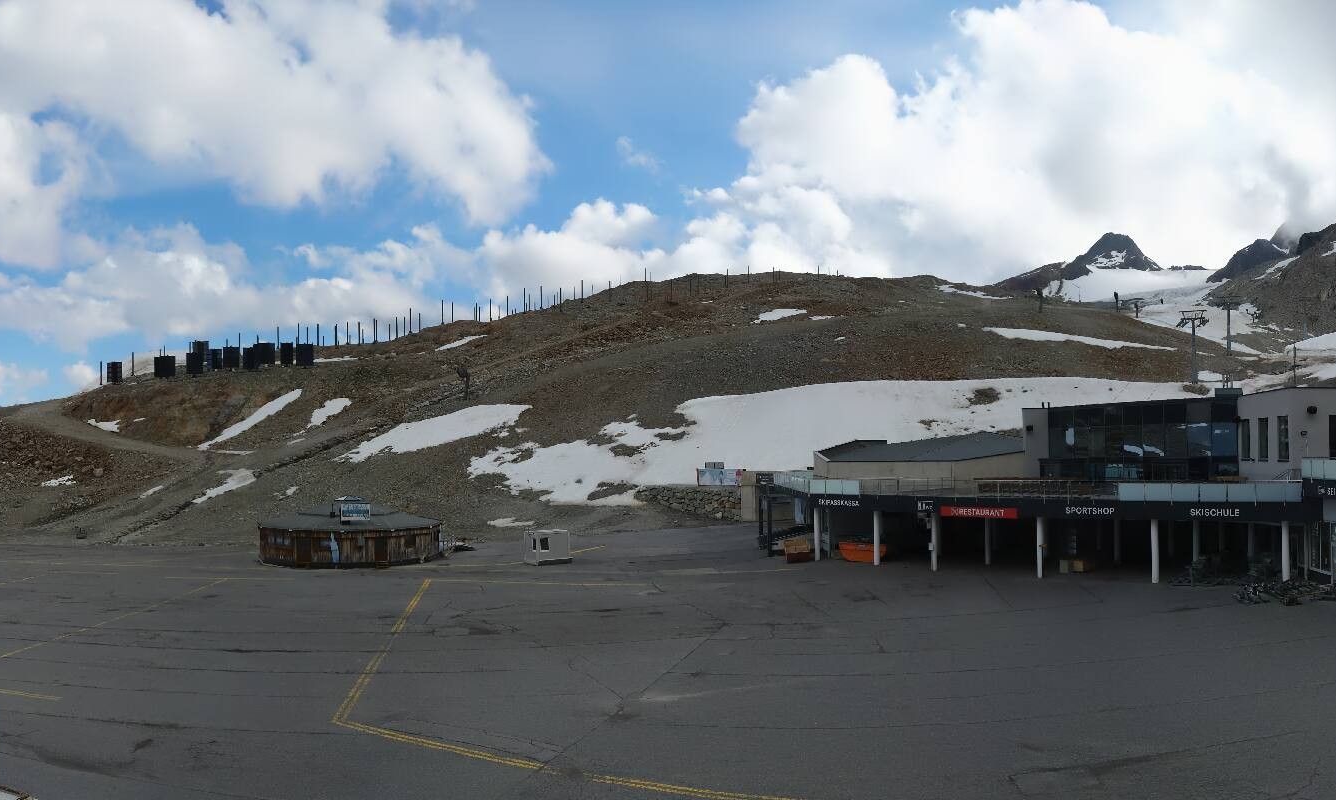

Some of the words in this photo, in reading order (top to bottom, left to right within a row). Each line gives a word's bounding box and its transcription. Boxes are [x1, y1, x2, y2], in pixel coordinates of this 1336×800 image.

[818, 498, 860, 507] SKIPASSKASSA
[958, 507, 1005, 517] RESTAURANT
[1065, 506, 1115, 515] SPORTSHOP
[1189, 508, 1240, 517] SKISCHULE
